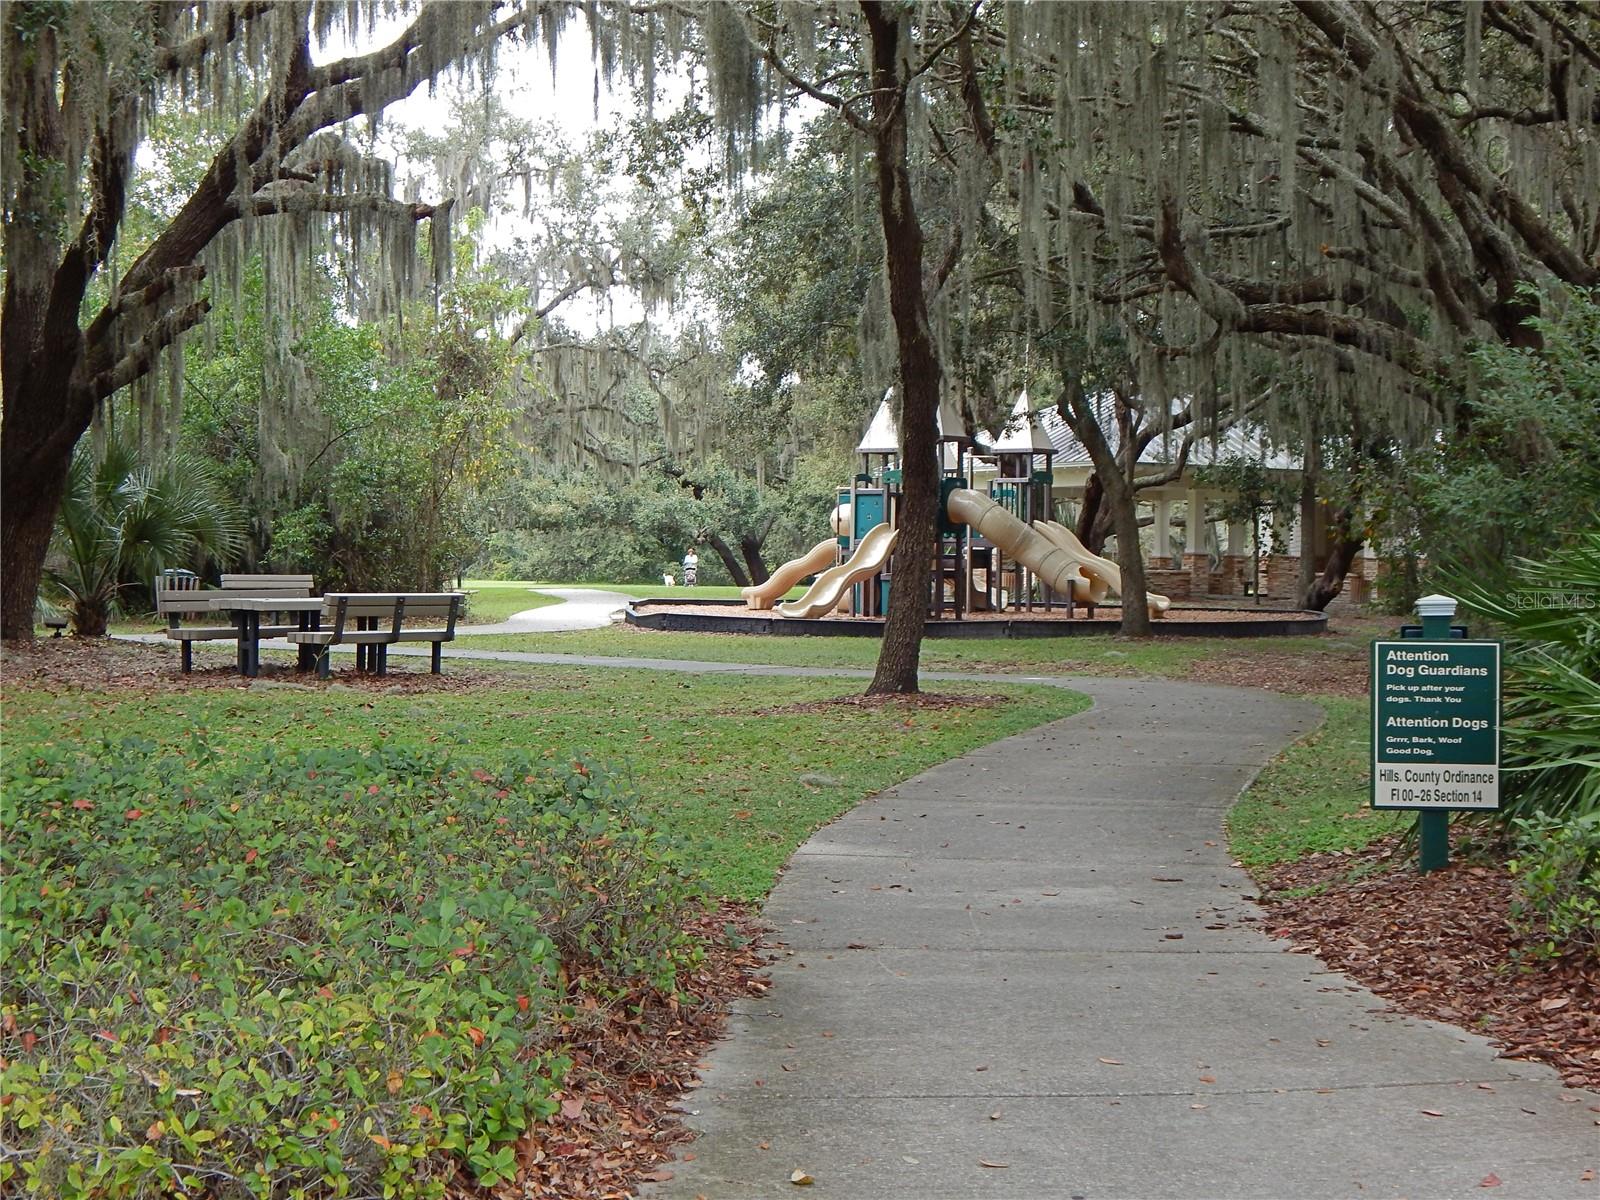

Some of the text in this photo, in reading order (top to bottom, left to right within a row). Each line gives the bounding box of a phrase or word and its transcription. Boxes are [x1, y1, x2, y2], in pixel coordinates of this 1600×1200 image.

[1386, 650, 1449, 662] Attention
[1386, 664, 1488, 677] Dog Guardians
[1407, 685, 1420, 693] up
[1421, 684, 1443, 692] after
[1444, 685, 1465, 693] your
[1386, 696, 1412, 704] dogs.
[1386, 717, 1488, 730] Attention Dogs
[1412, 736, 1436, 744] Bark,
[1379, 769, 1494, 785] Hills. County Ordinance
[1433, 790, 1470, 802] Section
[1473, 790, 1483, 802] 14
